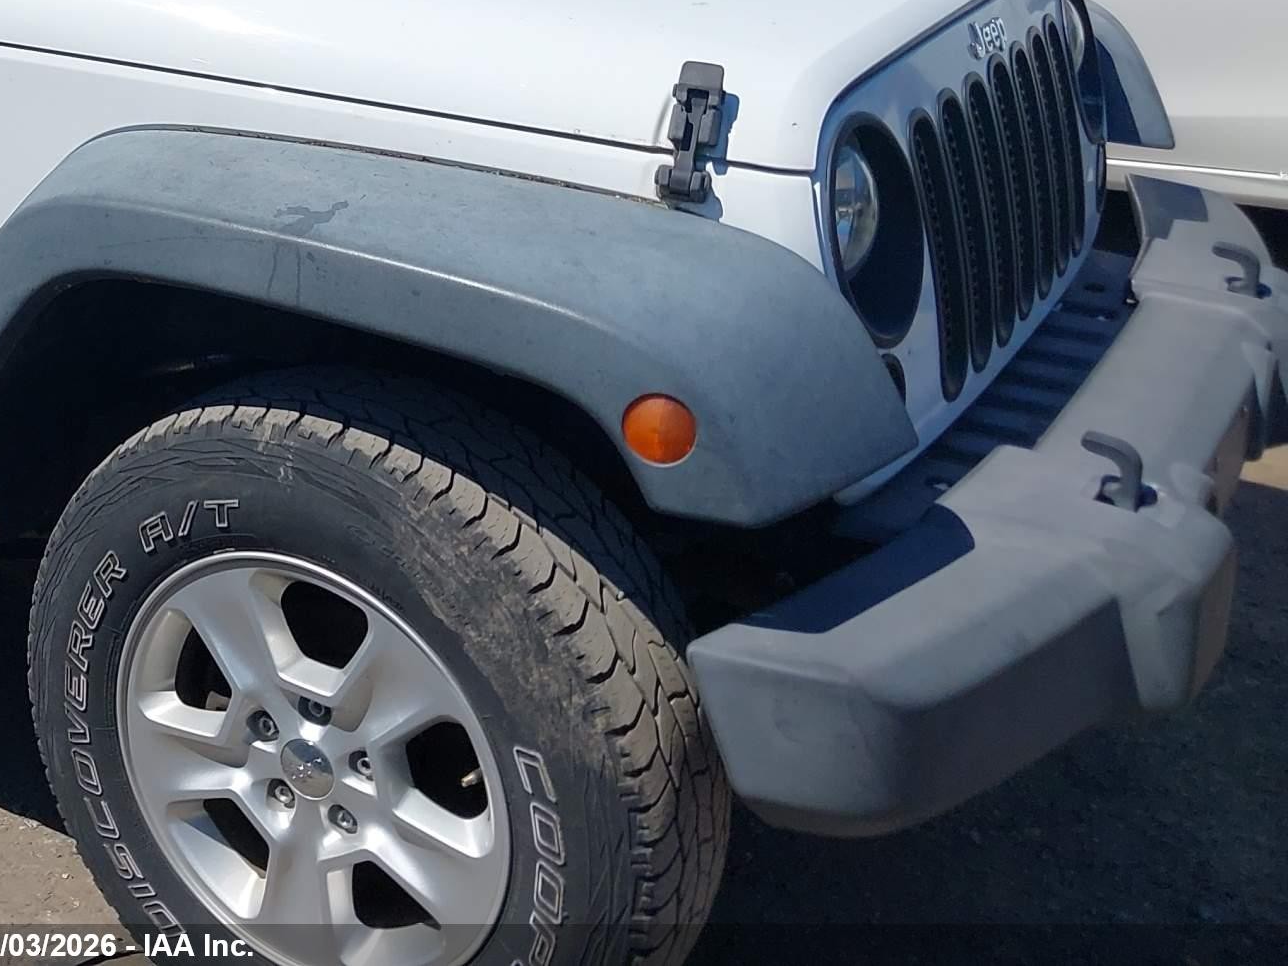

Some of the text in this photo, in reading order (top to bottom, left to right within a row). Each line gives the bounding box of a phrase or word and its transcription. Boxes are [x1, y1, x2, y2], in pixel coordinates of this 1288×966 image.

[970, 17, 1007, 59] Jeep
[64, 499, 239, 938] DISCOVERER A/T
